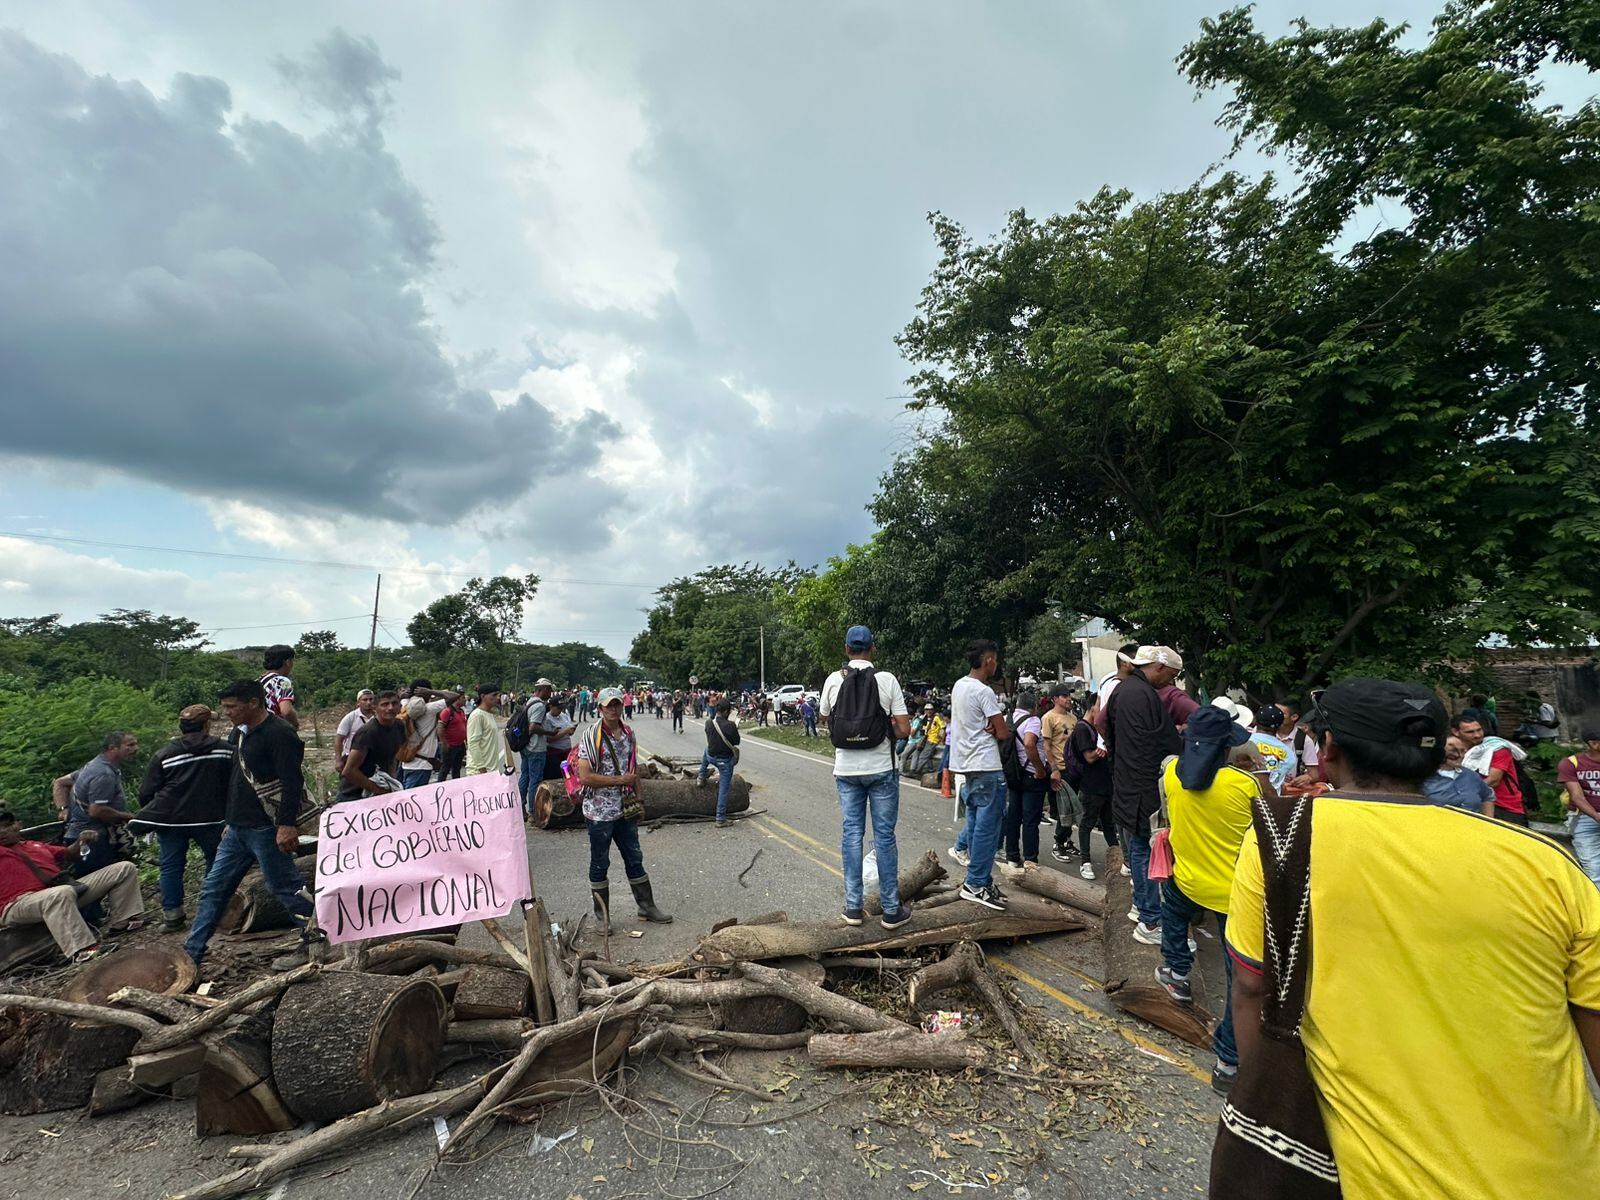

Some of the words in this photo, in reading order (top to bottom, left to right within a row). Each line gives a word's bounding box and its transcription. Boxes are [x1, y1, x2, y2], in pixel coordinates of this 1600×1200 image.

[323, 794, 424, 840] EXIGIMOS
[463, 789, 519, 819] PRESENCIA
[319, 843, 362, 876] del
[372, 820, 485, 869] GOBIERNO
[337, 869, 506, 936] NACIONAL
